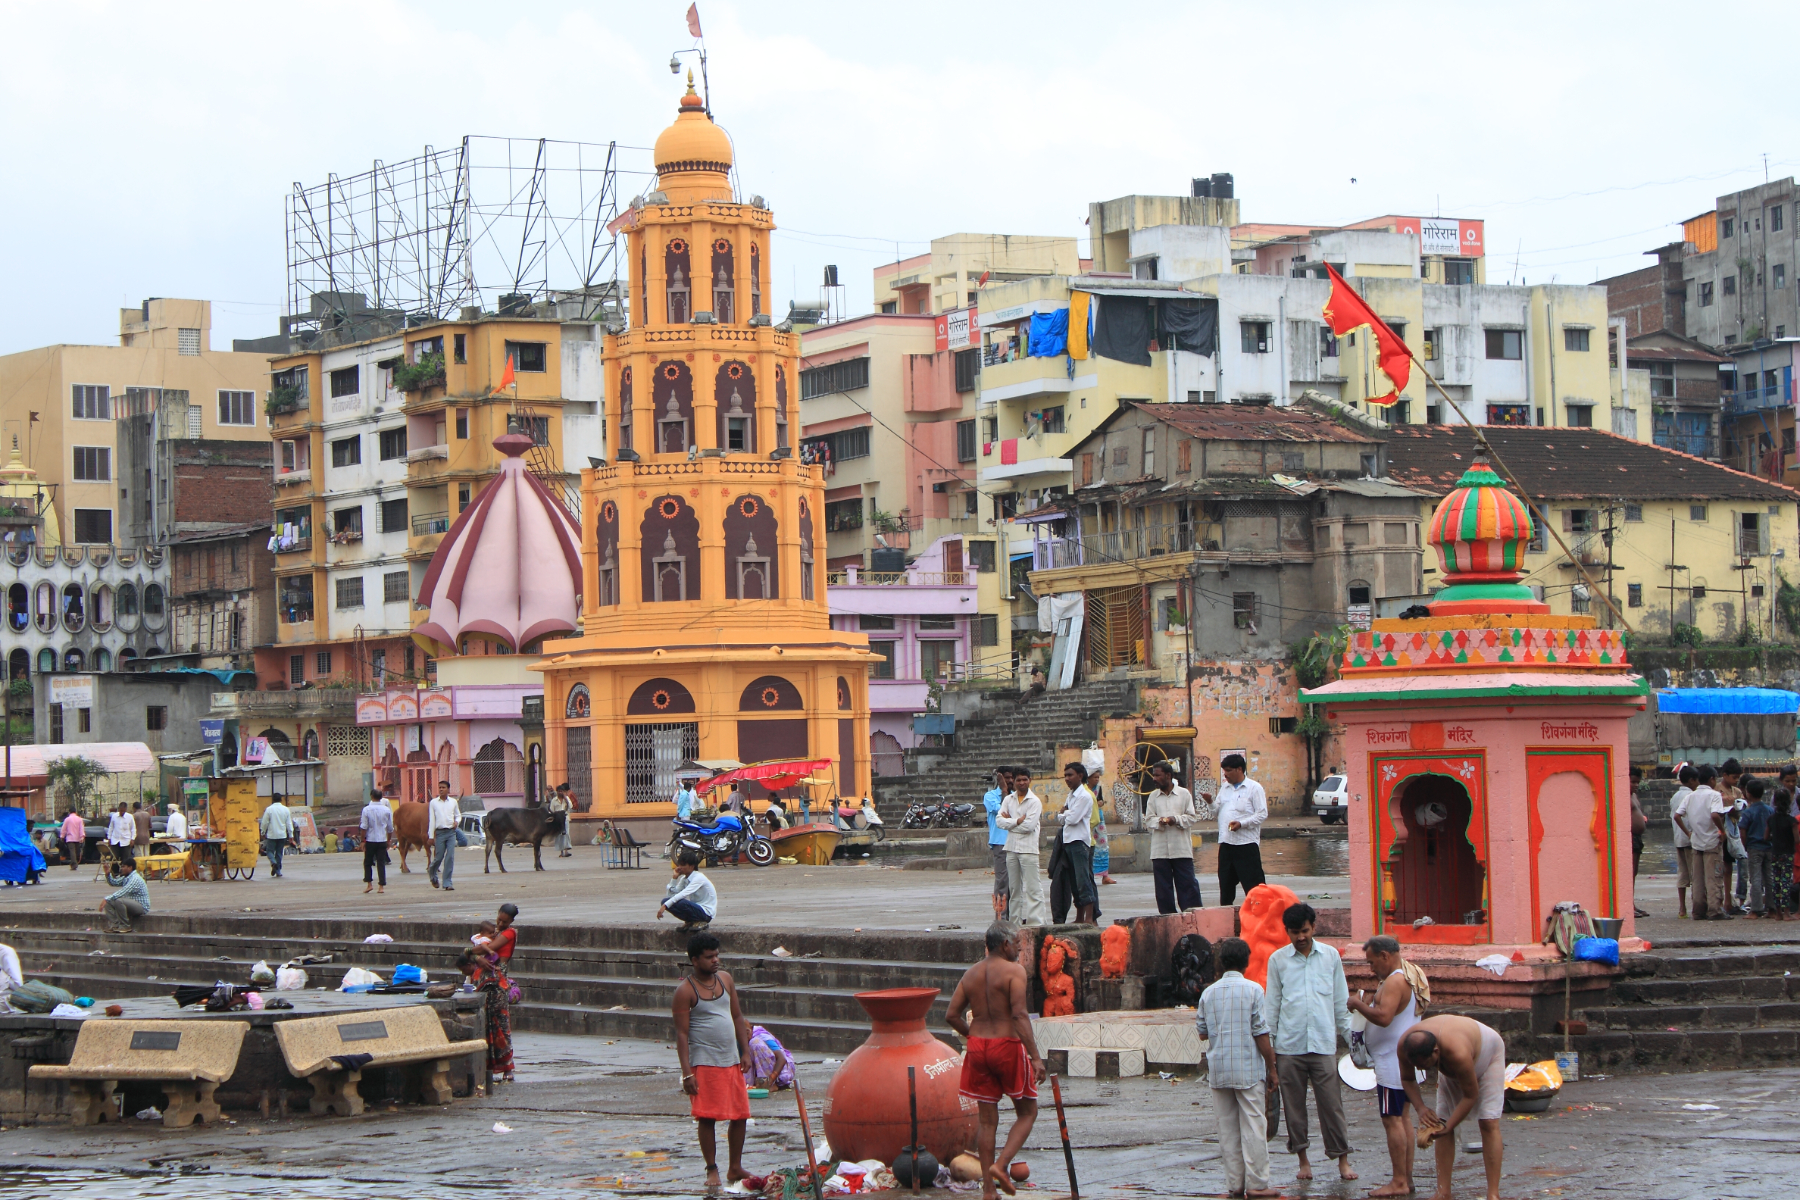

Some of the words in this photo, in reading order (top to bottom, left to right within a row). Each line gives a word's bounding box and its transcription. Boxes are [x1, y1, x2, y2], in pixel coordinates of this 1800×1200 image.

[1422, 222, 1458, 240] गोरेराम
[1351, 612, 1367, 621] 26
[1366, 728, 1408, 744] शिवगंगा
[1447, 726, 1476, 743] मंदिर
[1541, 721, 1577, 740] शिवगंगा
[1577, 721, 1600, 742] मंदिर
